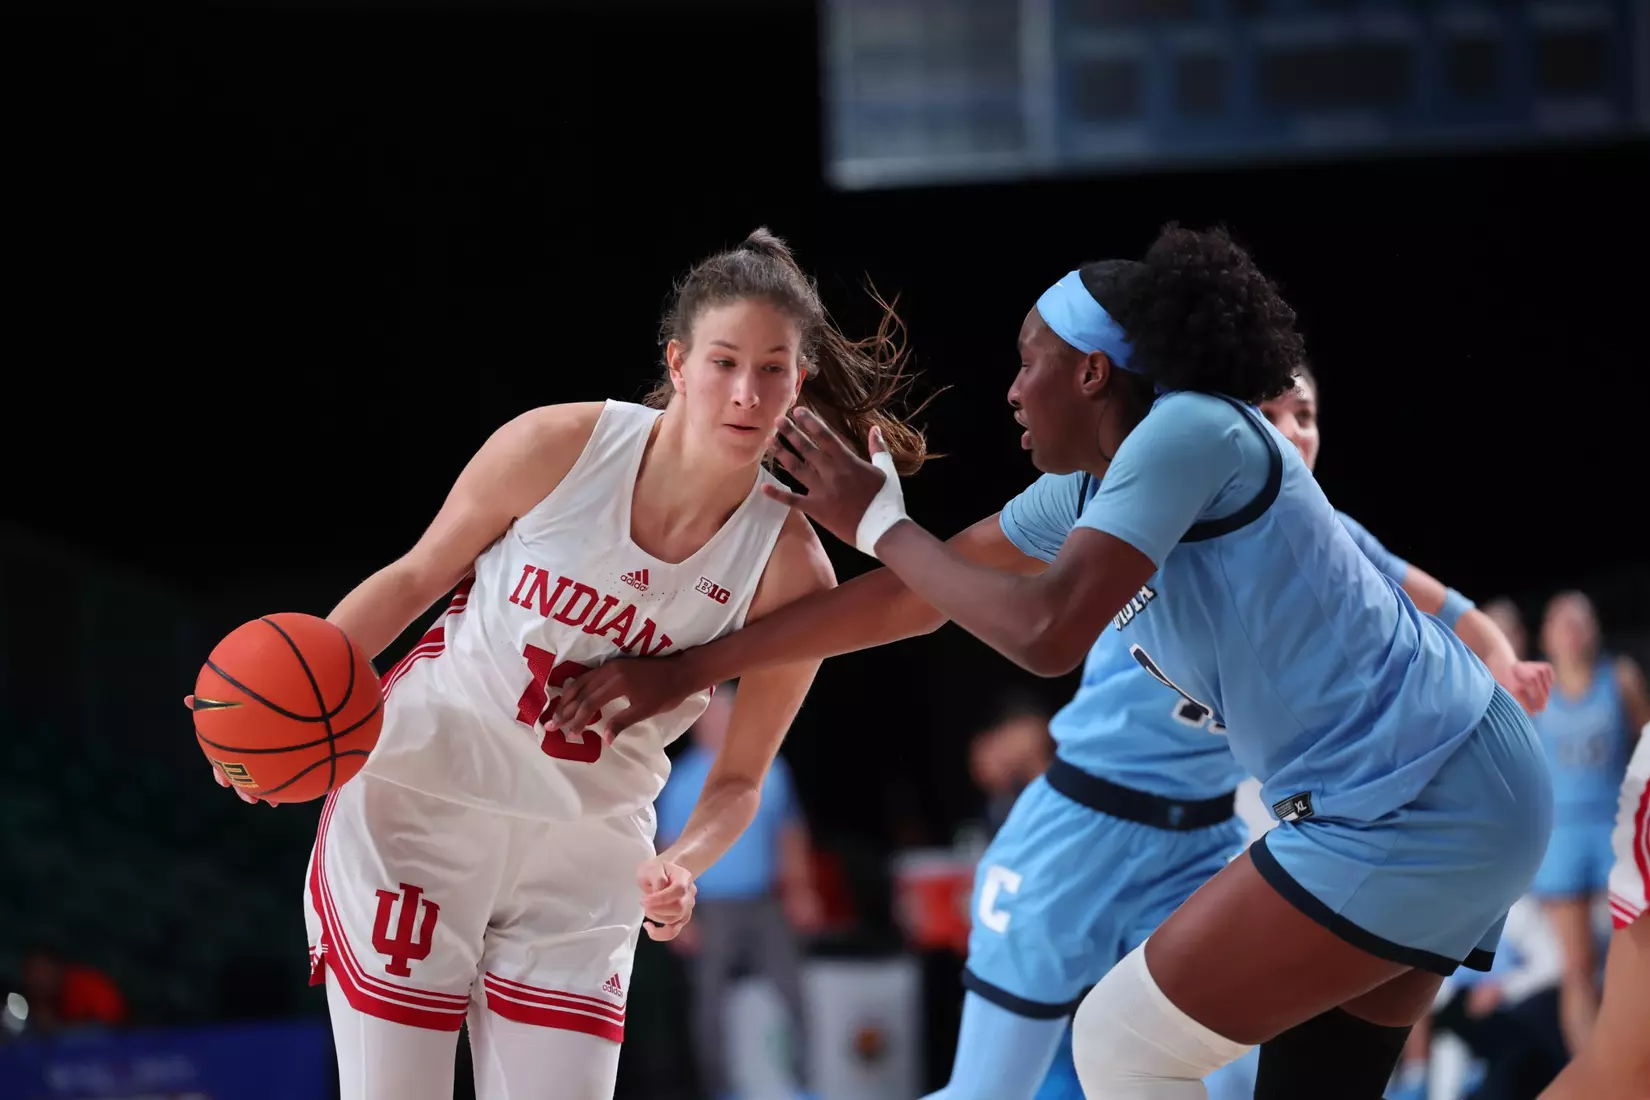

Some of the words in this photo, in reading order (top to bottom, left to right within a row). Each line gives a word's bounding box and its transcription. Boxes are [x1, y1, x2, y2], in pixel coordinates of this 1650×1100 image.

[508, 564, 684, 657] INDIAN
[1294, 800, 1308, 813] XL
[979, 864, 1023, 934] C
